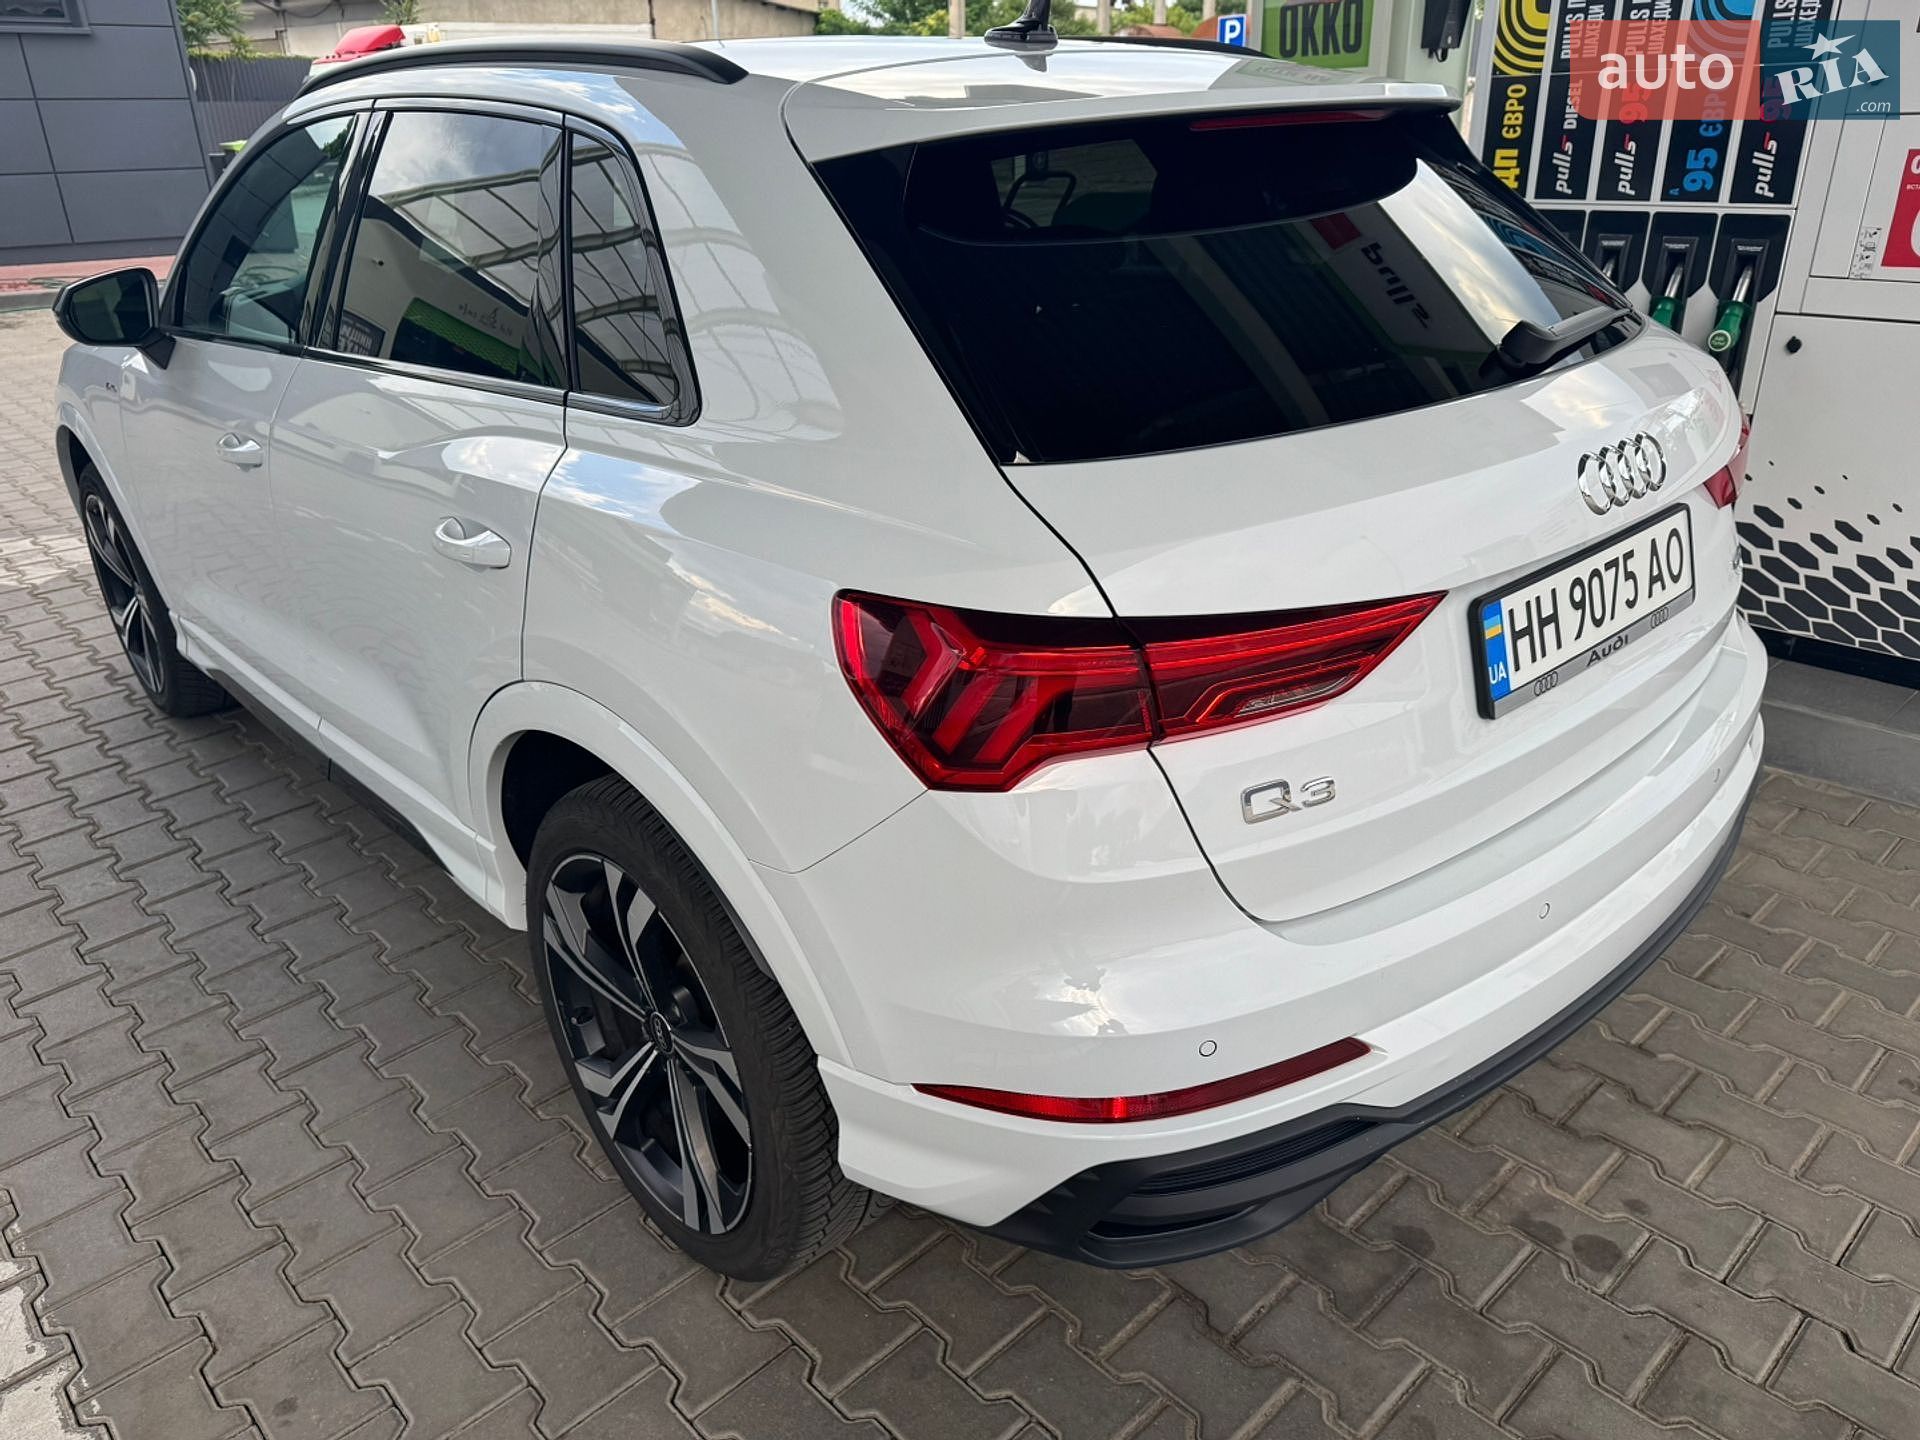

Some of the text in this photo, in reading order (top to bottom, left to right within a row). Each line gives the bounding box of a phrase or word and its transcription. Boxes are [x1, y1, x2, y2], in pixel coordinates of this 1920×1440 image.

[1224, 20, 1241, 45] P
[1501, 84, 1527, 139] ЄВРО
[1552, 79, 1583, 194] pulls DIESEL
[1614, 134, 1637, 195] pulls
[1683, 148, 1718, 192] 95
[1752, 132, 1778, 198] pulls
[1508, 528, 1684, 672] HH 9075 AO
[1489, 662, 1507, 684] UA
[1586, 634, 1629, 668] Audi
[1241, 776, 1336, 825] Q3
